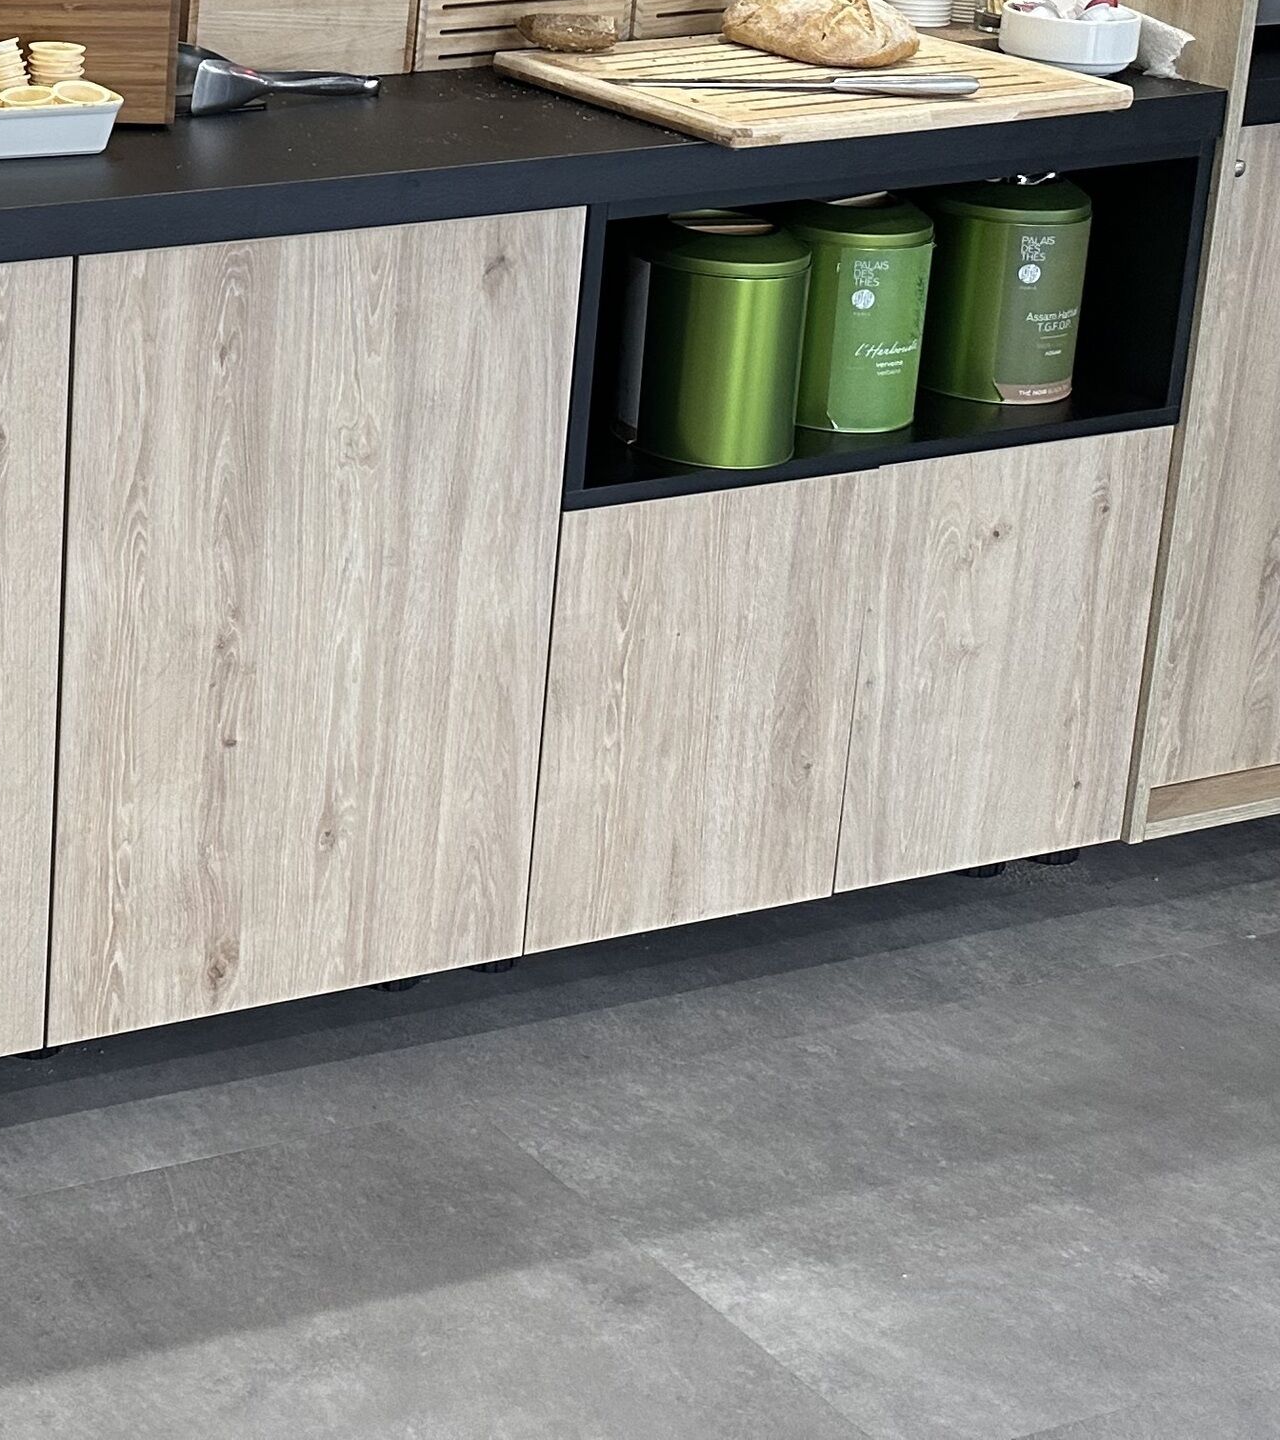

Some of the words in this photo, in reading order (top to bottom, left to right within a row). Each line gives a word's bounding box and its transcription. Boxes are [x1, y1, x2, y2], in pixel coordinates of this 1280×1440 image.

[1021, 235, 1056, 246] PALAIS
[1021, 244, 1041, 254] DES
[854, 260, 889, 271] PALAIS
[853, 268, 874, 279] DES
